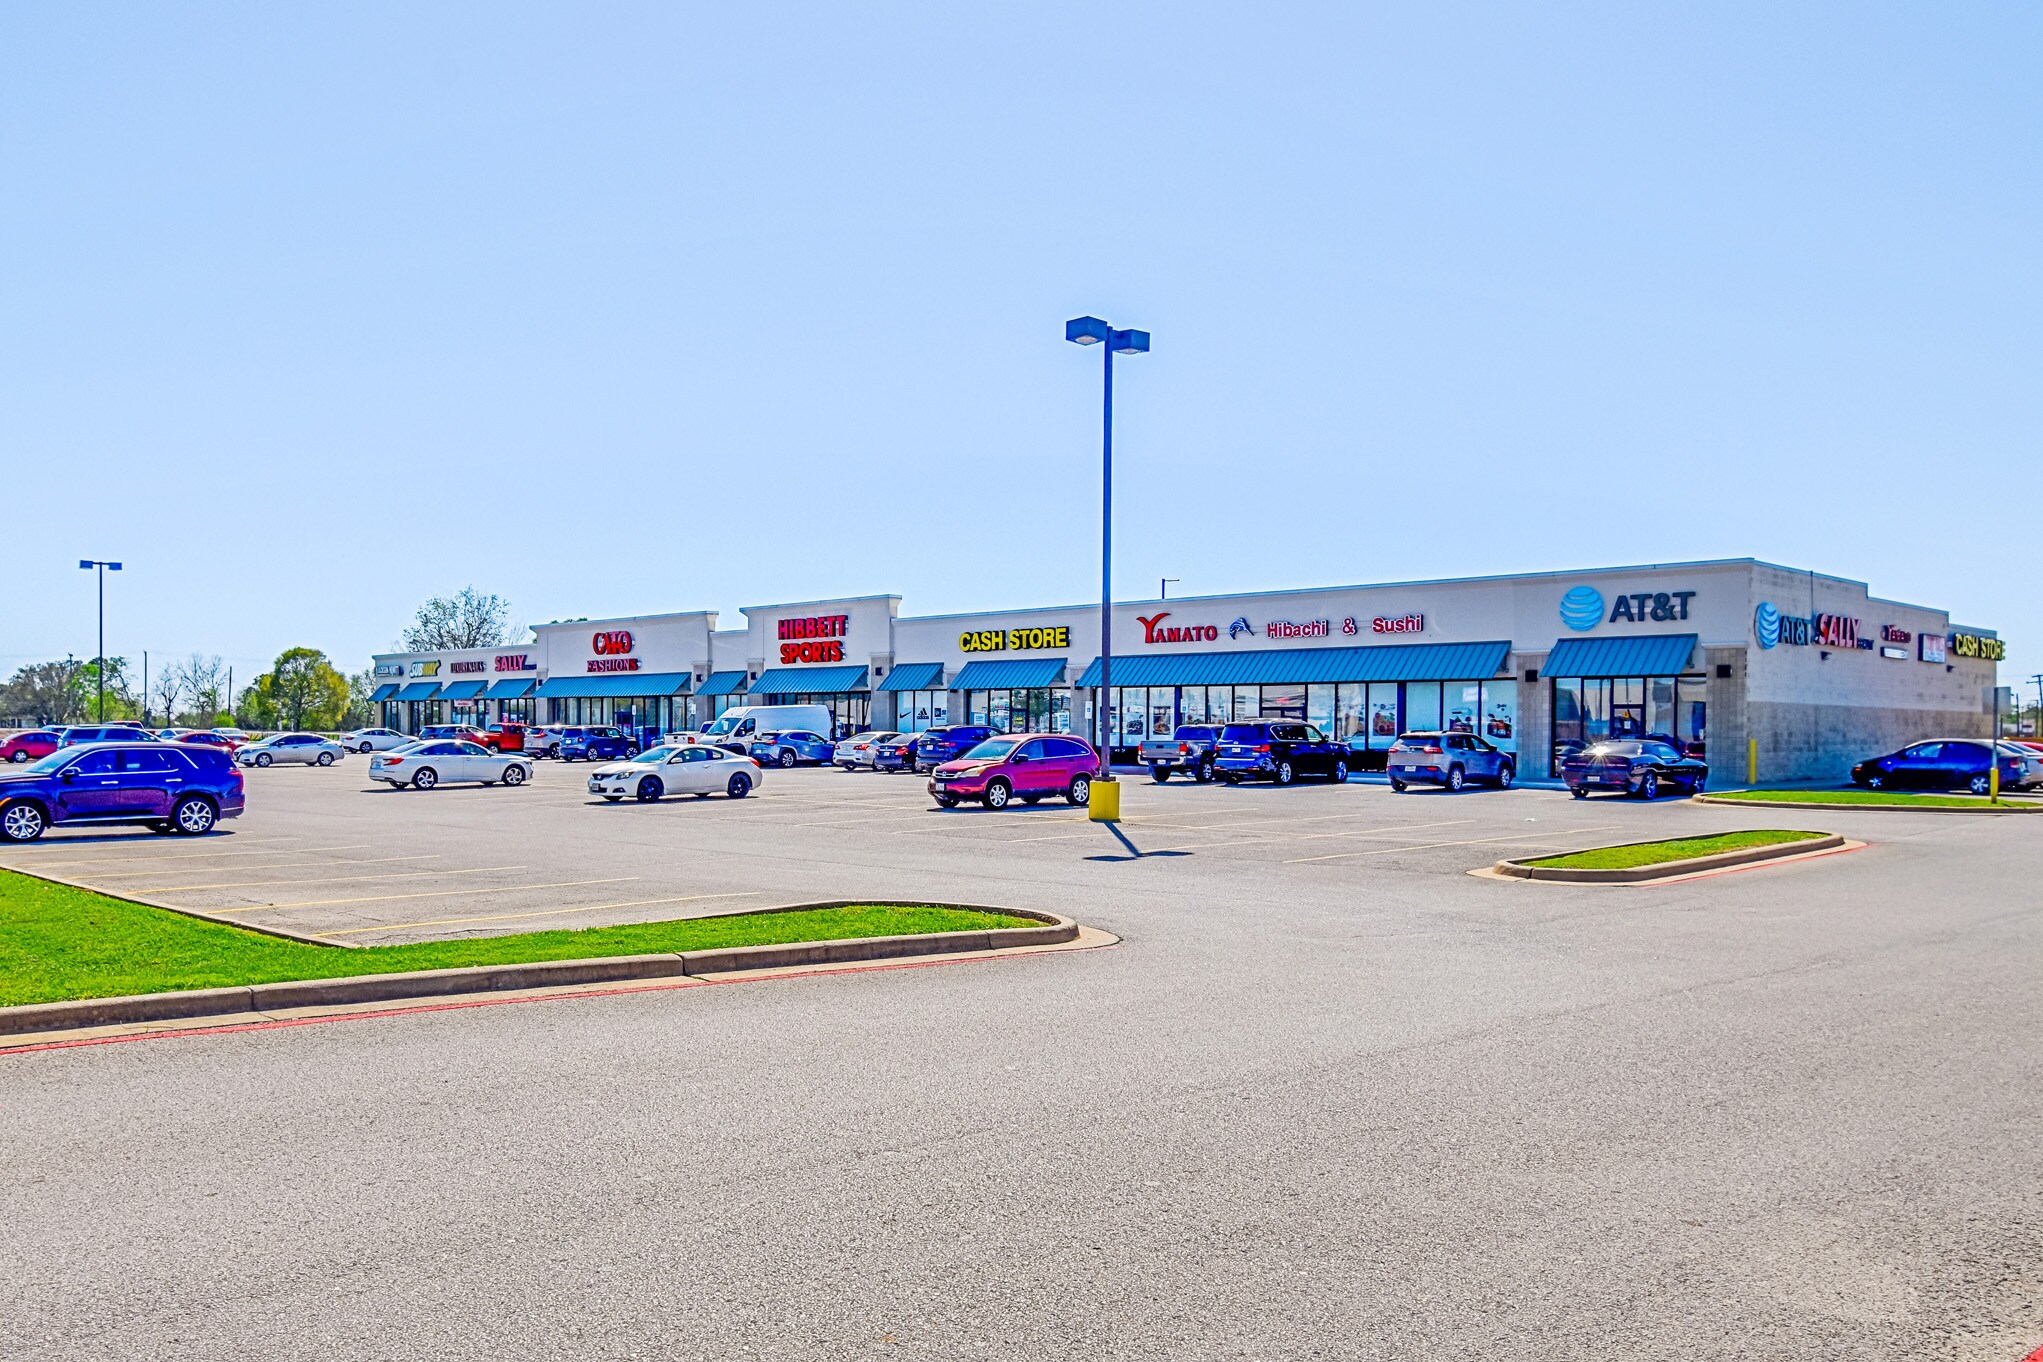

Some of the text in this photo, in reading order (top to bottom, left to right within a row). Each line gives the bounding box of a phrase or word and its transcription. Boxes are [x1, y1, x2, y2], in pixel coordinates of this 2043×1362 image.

[1608, 590, 1696, 622] AT&T
[778, 615, 848, 640] HIBBETT
[959, 626, 1069, 652] CASH STORE
[1136, 613, 1217, 643] YAMATO
[1266, 614, 1424, 639] Hibachi & Sushi
[1779, 616, 1811, 646] AT&T
[1817, 613, 1862, 648] SALLY
[780, 640, 843, 664] SPORTS
[1955, 633, 1979, 657] CASH
[1981, 637, 2006, 661] STORE
[409, 660, 441, 678] SUBWAY
[495, 655, 526, 672] SALLY
[587, 658, 638, 672] FASHIONS
